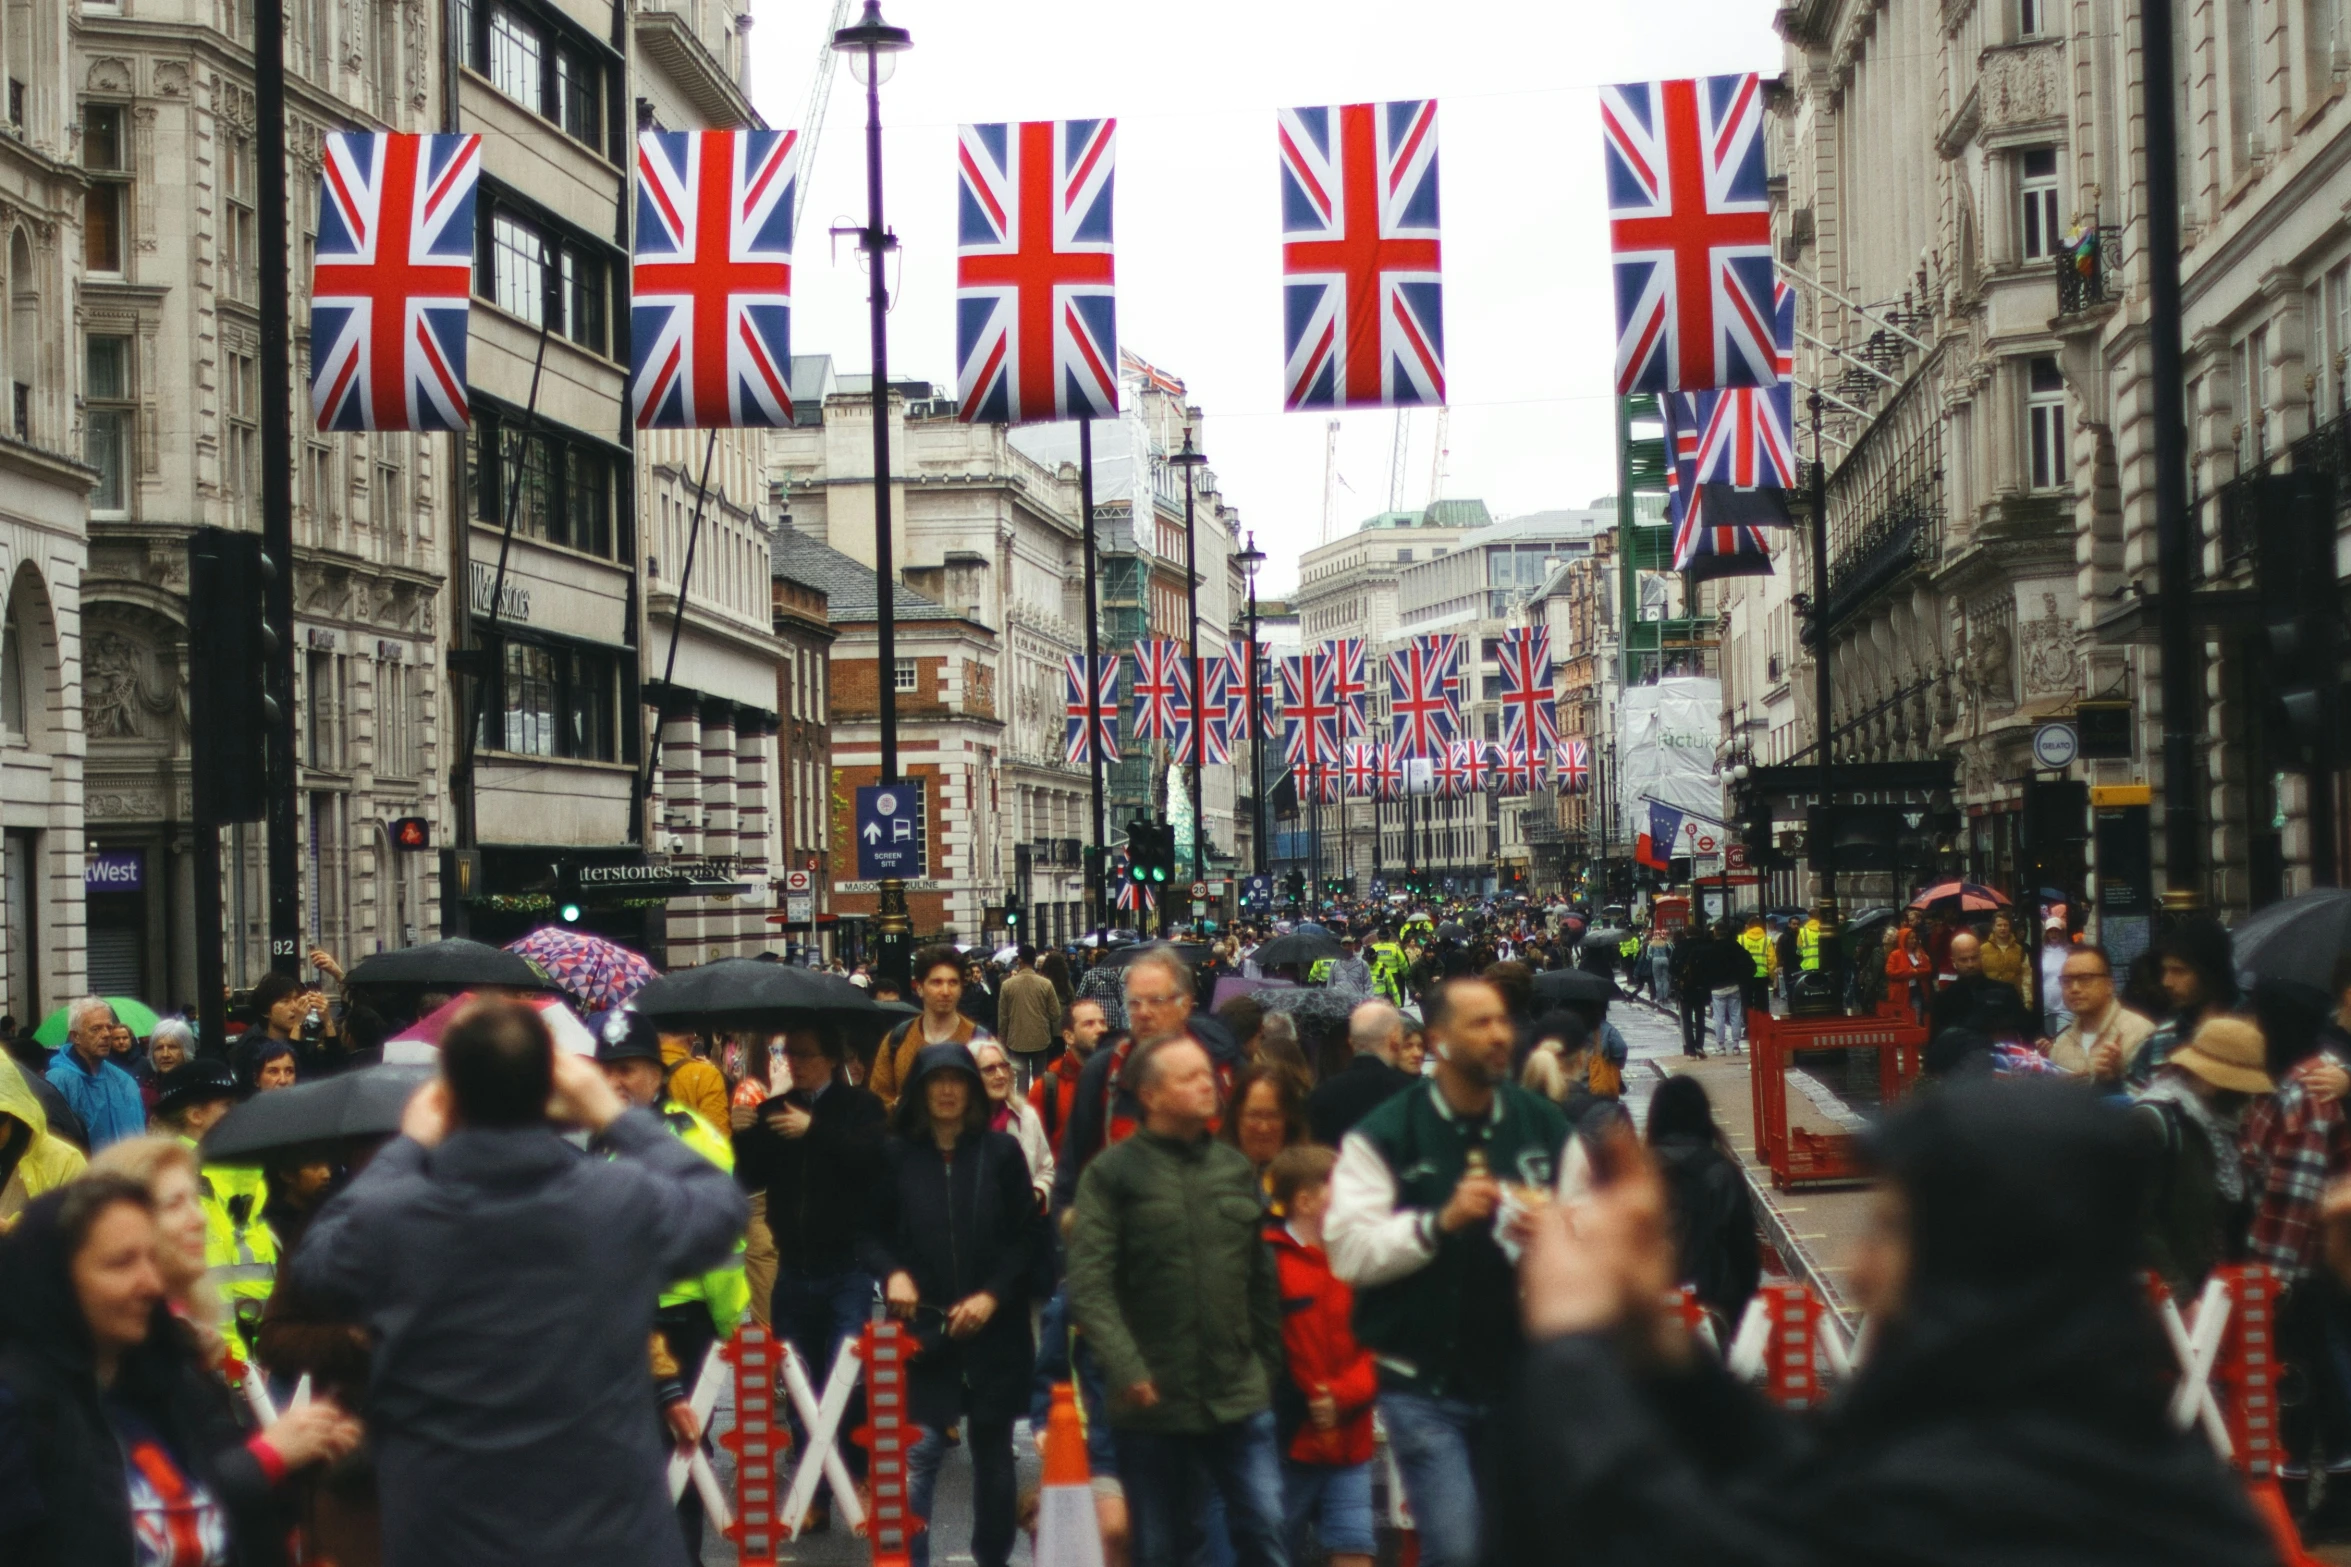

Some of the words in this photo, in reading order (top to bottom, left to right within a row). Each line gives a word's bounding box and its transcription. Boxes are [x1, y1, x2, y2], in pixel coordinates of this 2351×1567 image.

[470, 562, 530, 619] Watstones
[2042, 742, 2071, 750] GELATO
[1786, 793, 1837, 810] TH
[1853, 789, 1934, 805] DILLY
[874, 852, 902, 860] SCREEN
[809, 860, 816, 870] S
[881, 860, 897, 868] SITE
[551, 862, 673, 883] terstones
[1193, 885, 1205, 894] 20
[884, 934, 897, 943] 81
[273, 940, 294, 956] 82
